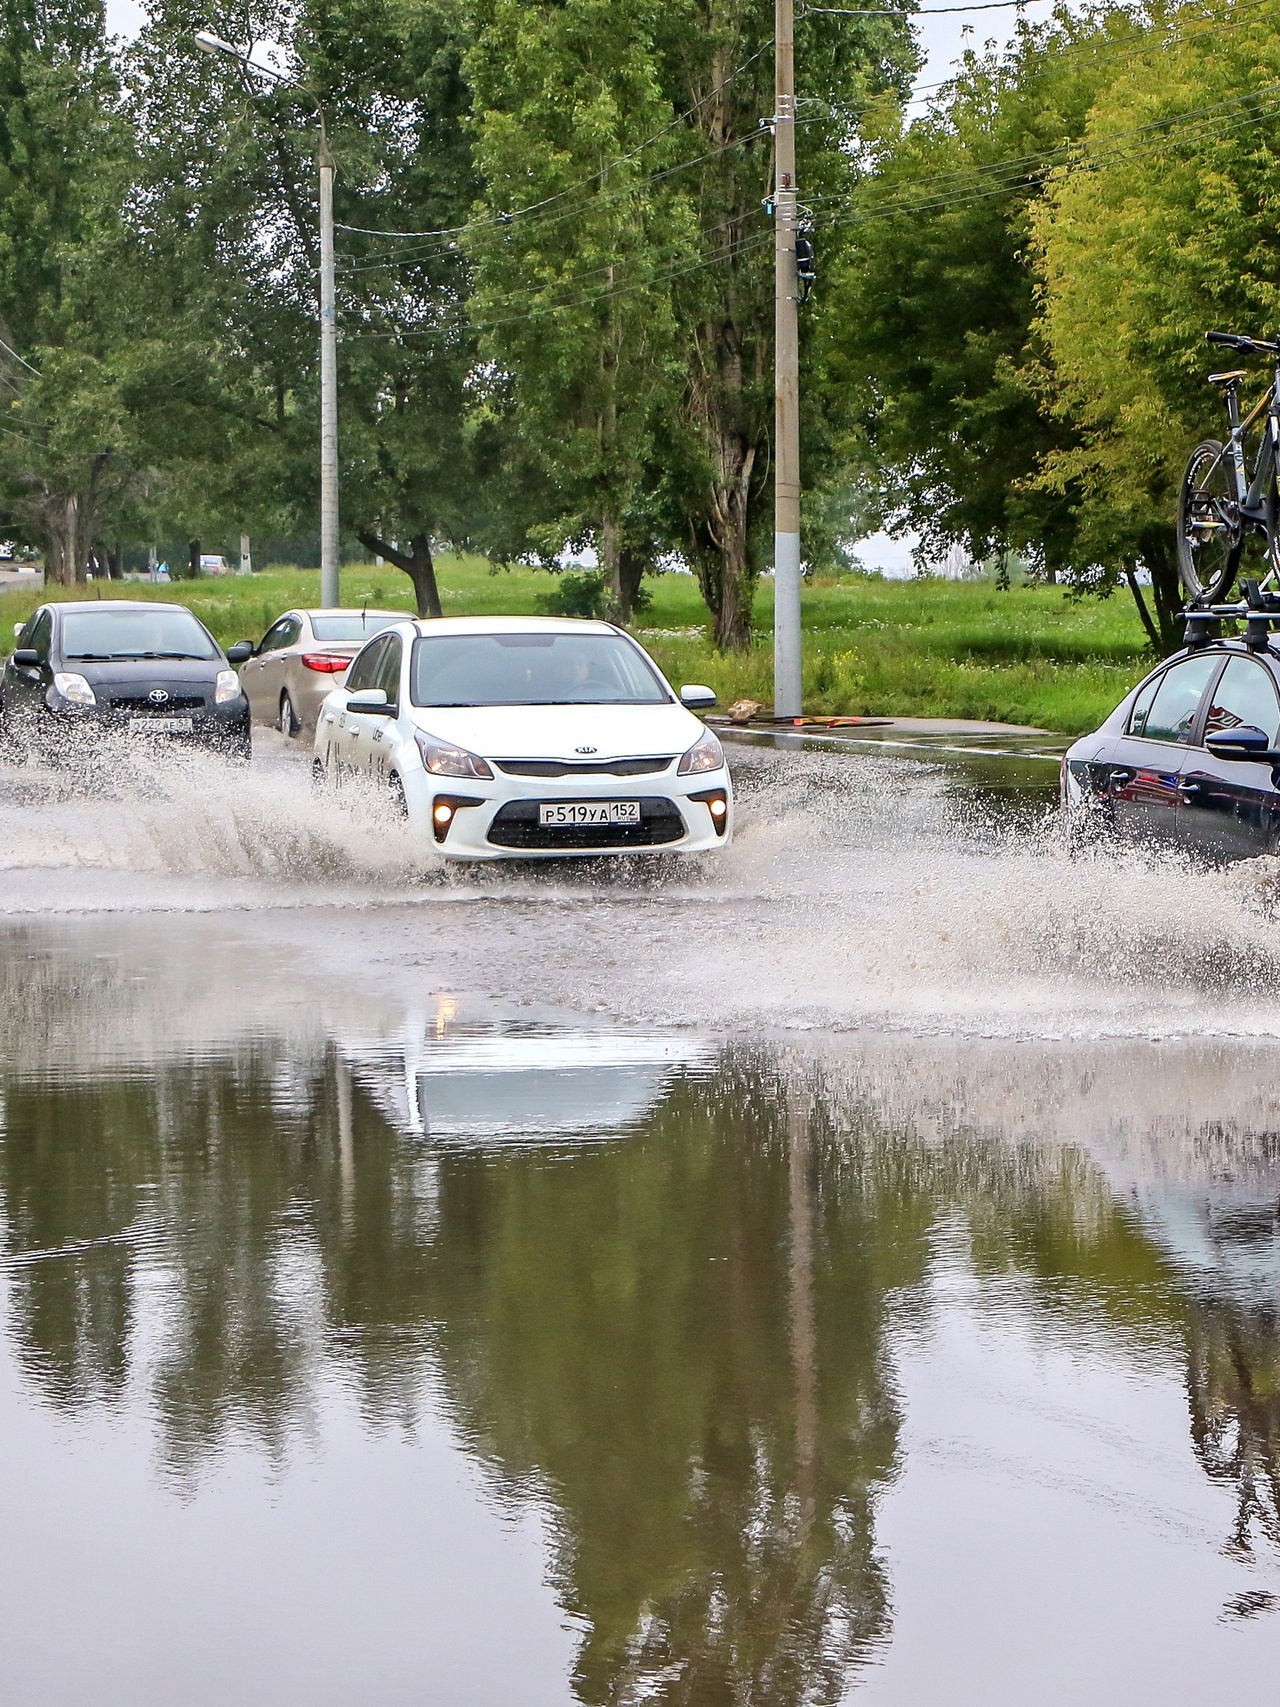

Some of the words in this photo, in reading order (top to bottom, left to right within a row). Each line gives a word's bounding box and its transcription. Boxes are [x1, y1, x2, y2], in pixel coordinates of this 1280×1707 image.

[577, 746, 596, 754] KIA
[545, 806, 609, 822] Р519УА
[612, 804, 636, 816] 152
